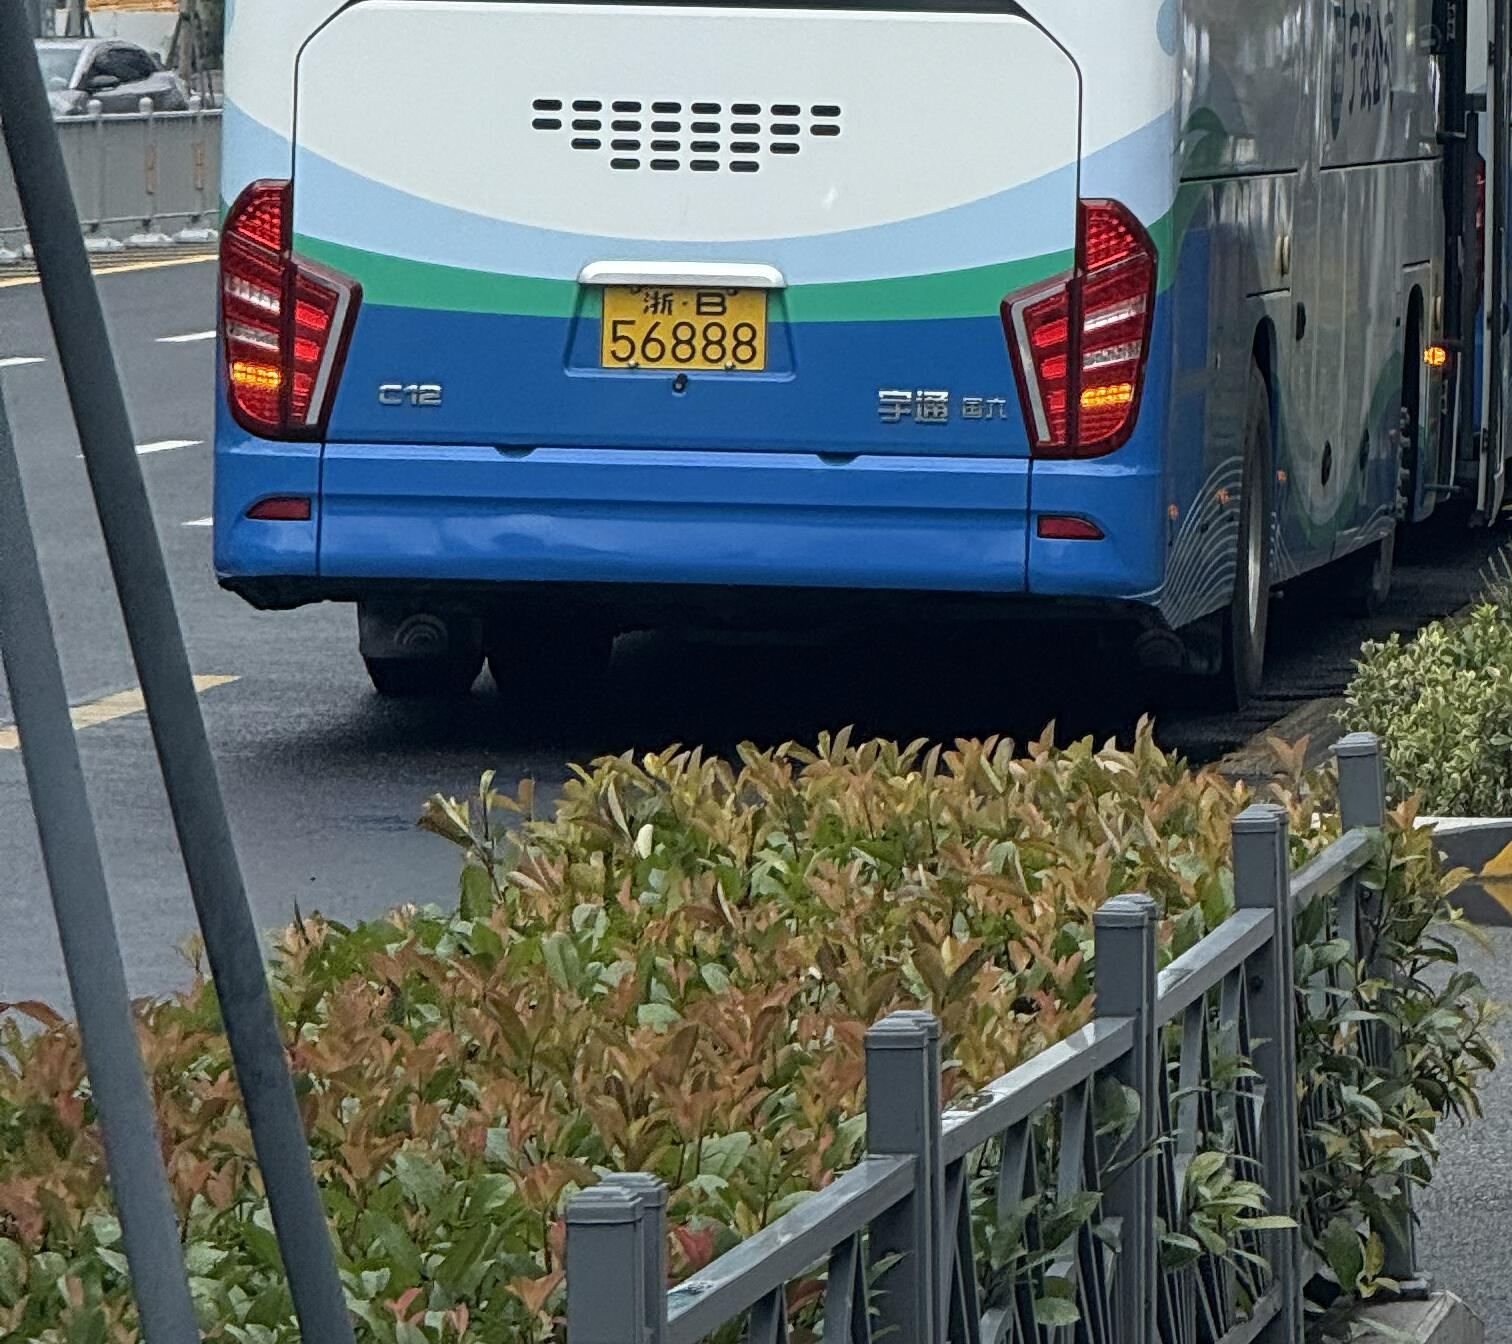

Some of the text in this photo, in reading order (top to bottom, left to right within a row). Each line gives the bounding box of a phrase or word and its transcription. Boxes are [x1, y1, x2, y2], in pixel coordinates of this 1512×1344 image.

[609, 318, 758, 364] 56888
[378, 383, 443, 406] C12
[877, 389, 949, 423] 宇通
